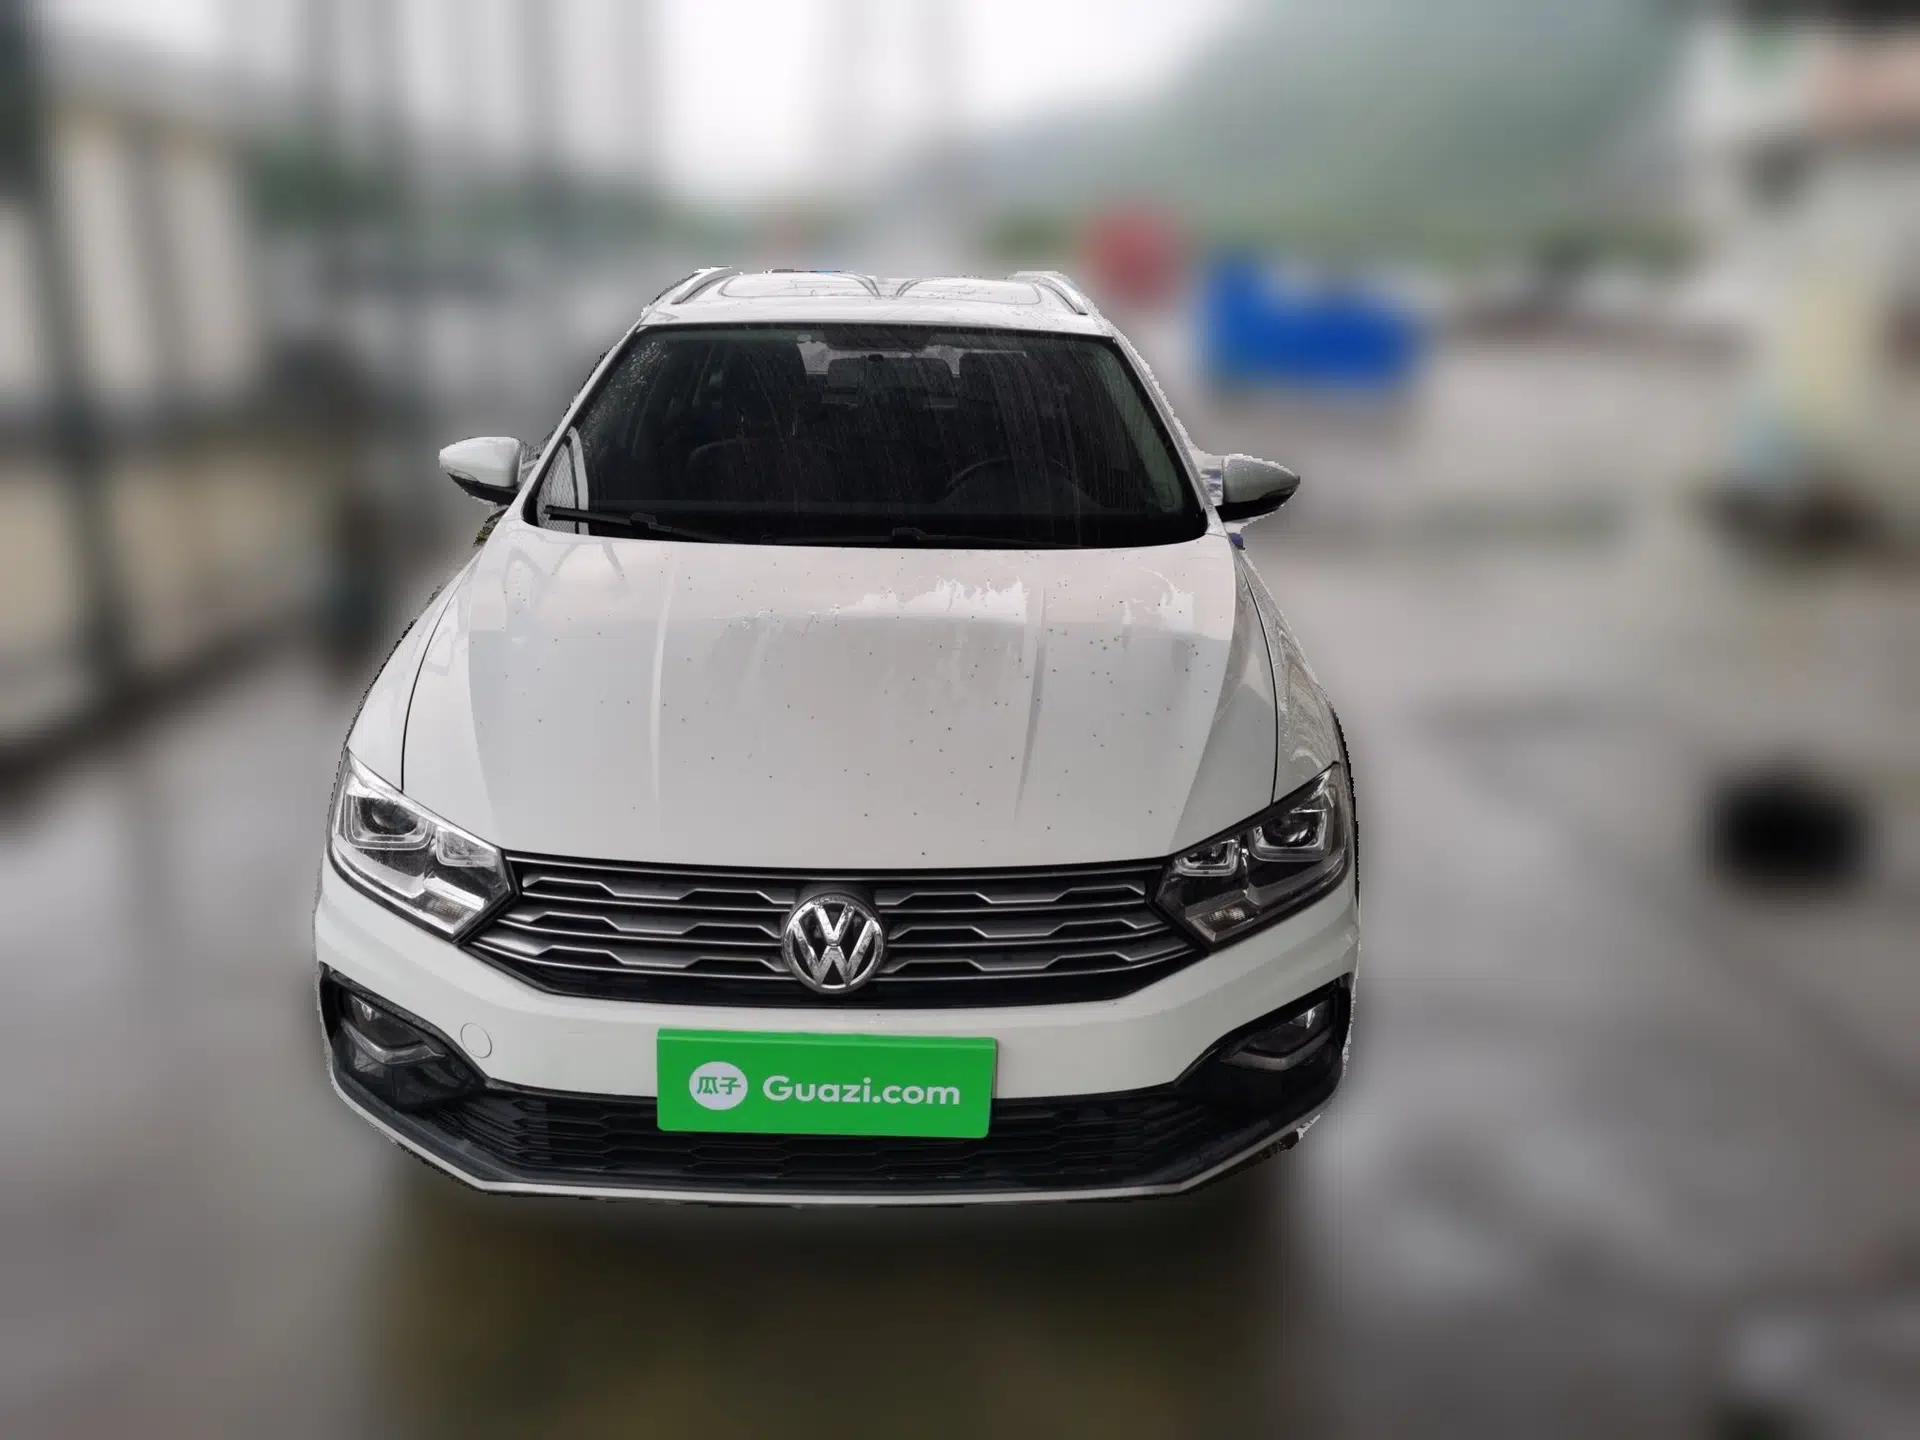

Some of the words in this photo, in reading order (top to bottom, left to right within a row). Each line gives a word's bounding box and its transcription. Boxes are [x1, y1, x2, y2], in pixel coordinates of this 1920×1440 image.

[786, 898, 881, 990] VW
[696, 1076, 742, 1097] 瓜子
[762, 1075, 961, 1106] Guazi.com
